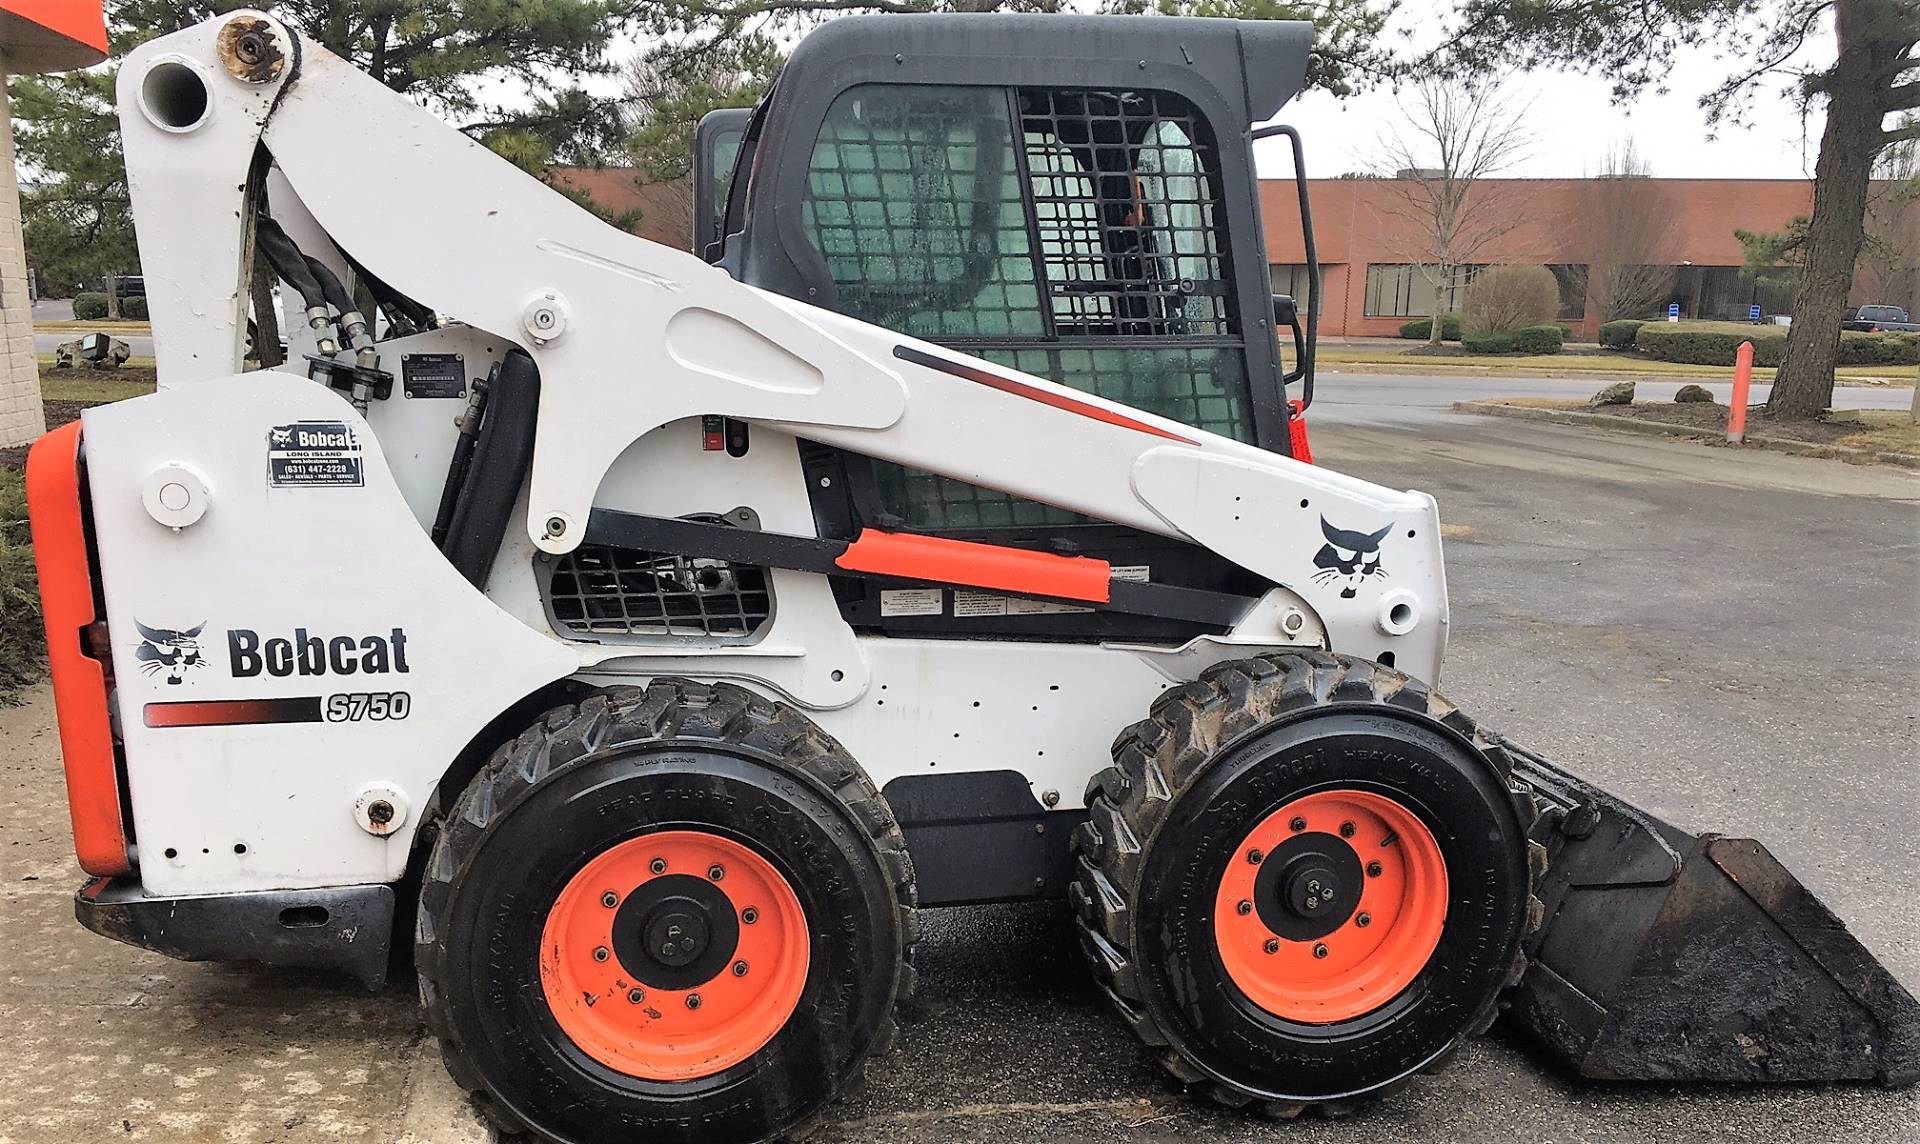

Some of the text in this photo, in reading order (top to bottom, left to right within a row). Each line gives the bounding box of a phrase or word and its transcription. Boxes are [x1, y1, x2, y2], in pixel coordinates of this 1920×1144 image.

[298, 431, 352, 447] Bobcat
[285, 465, 347, 474] (631) 447-2228
[227, 628, 410, 677] Bobcat
[327, 691, 410, 722] S750
